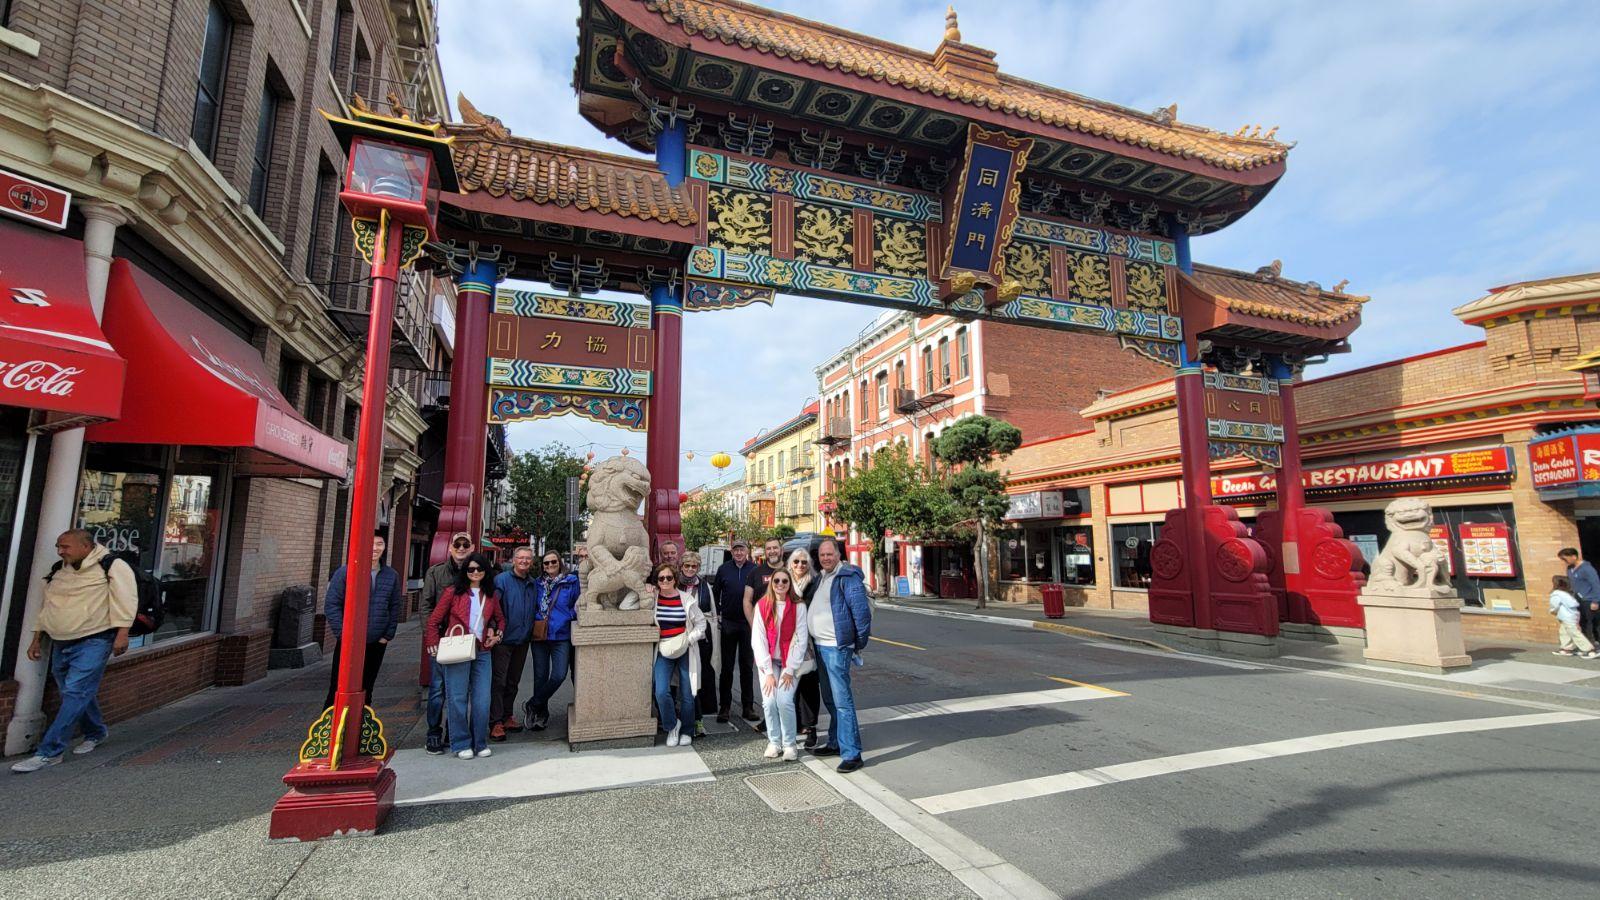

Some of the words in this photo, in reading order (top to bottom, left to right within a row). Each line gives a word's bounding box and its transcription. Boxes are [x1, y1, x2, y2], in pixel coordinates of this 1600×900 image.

[1550, 456, 1575, 469] Garden
[1222, 479, 1256, 493] Ocean
[1311, 458, 1445, 486] RESTAURANT
[1534, 467, 1576, 483] RESTAURANT
